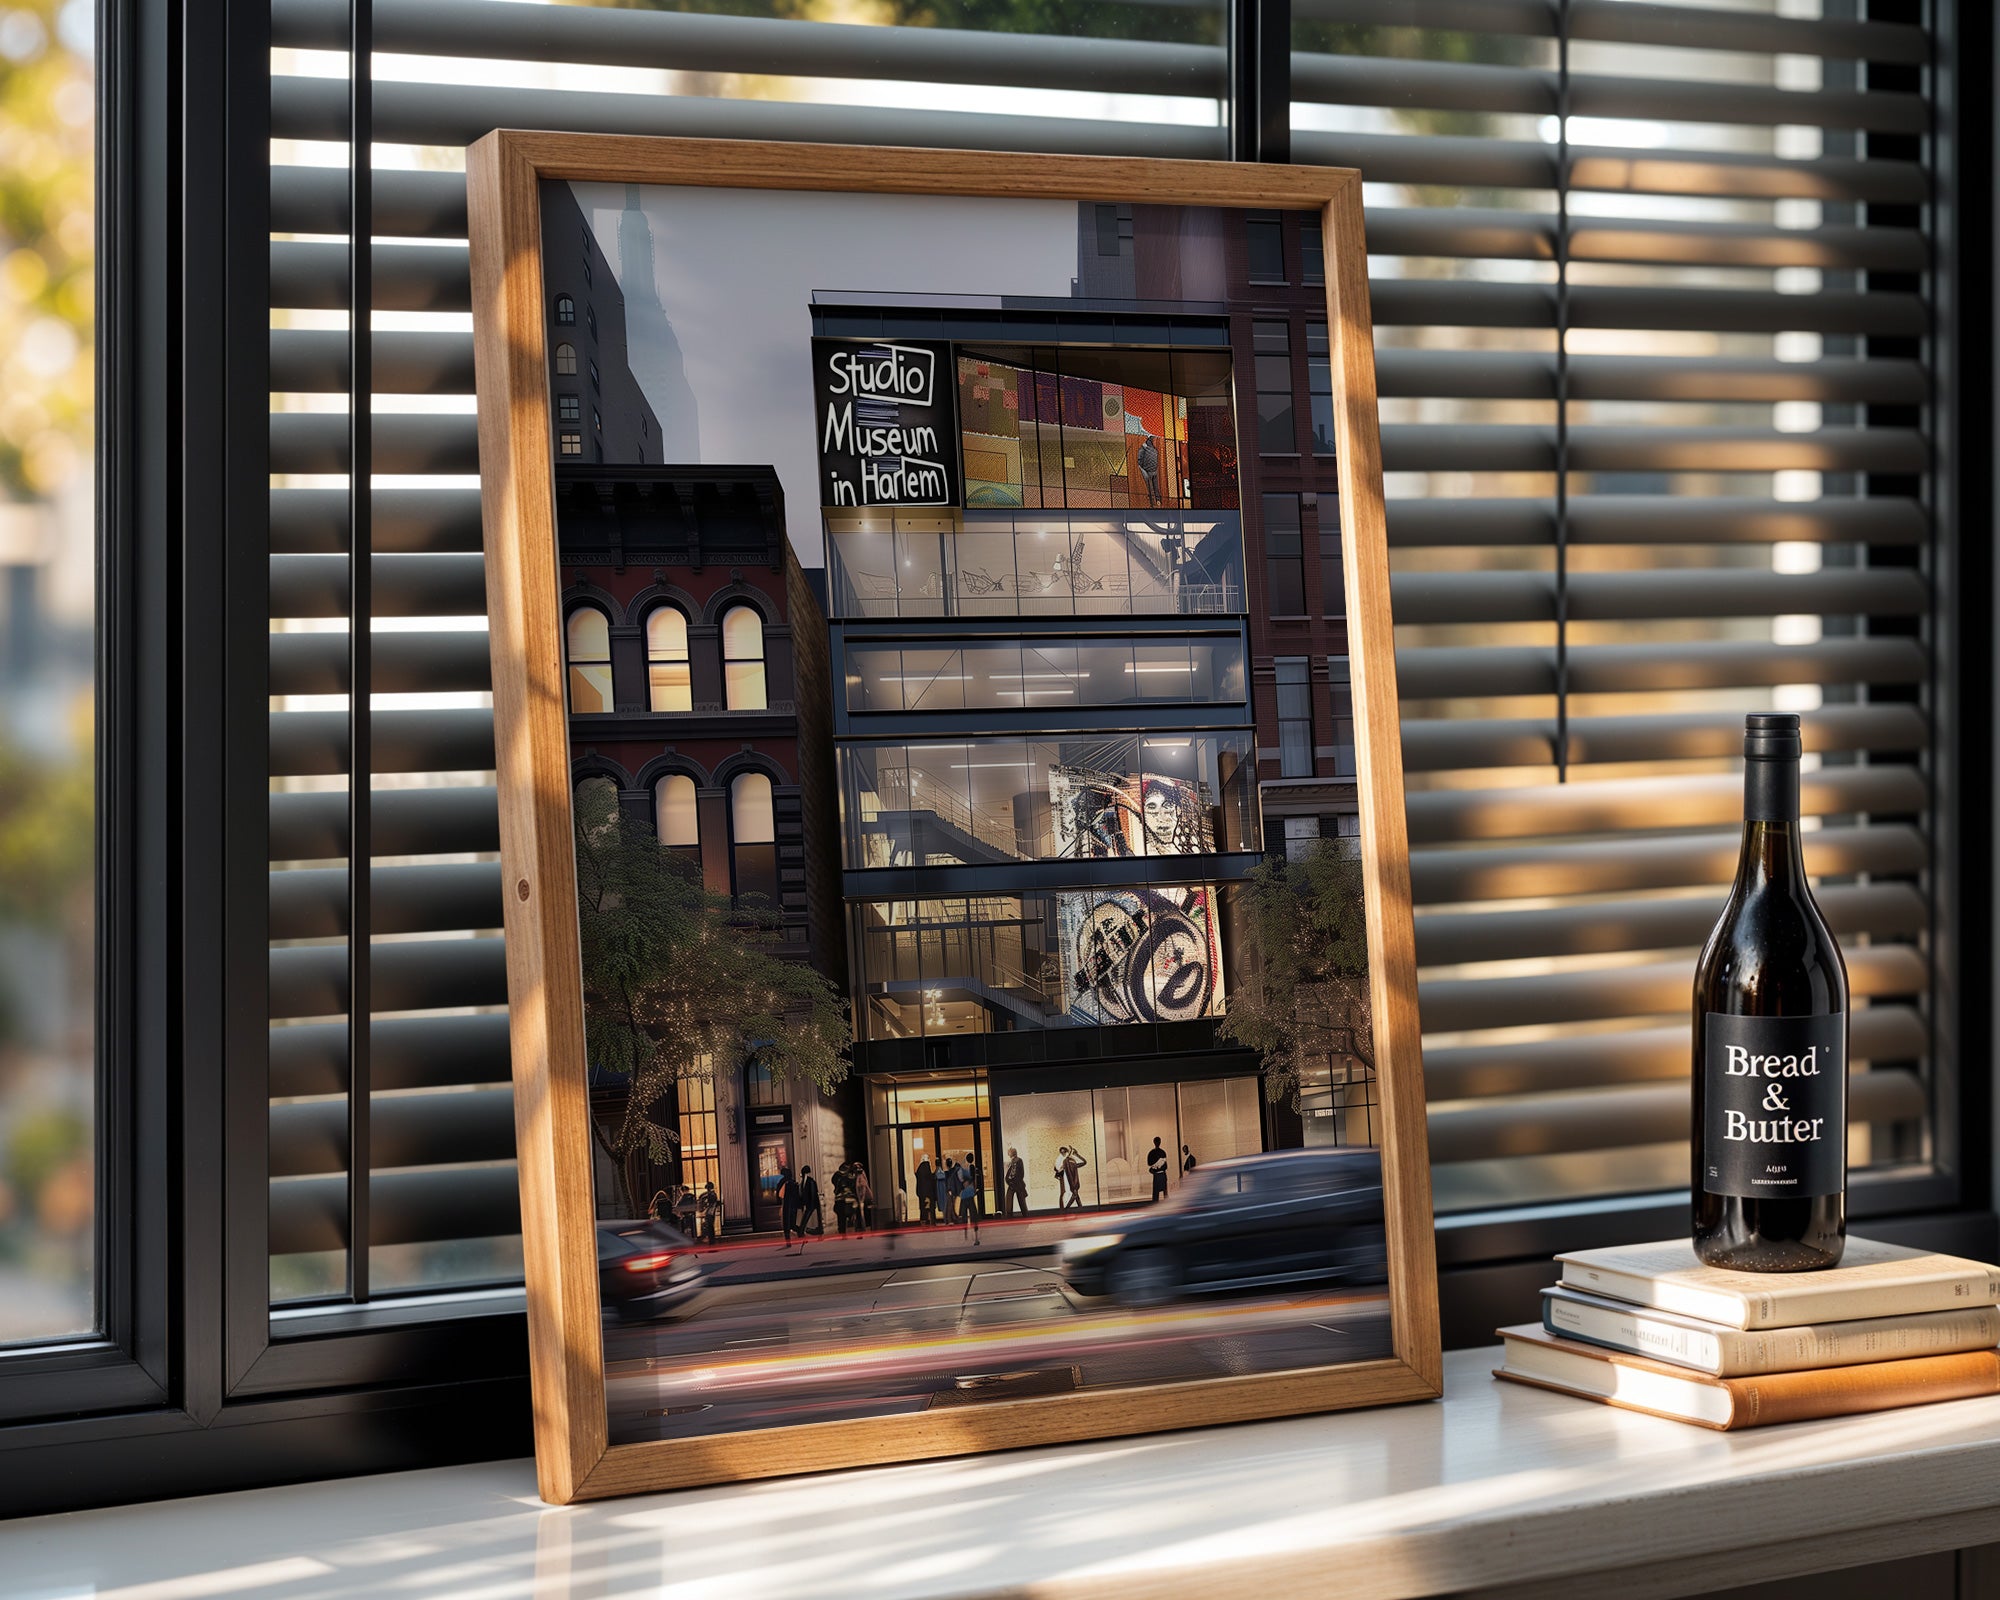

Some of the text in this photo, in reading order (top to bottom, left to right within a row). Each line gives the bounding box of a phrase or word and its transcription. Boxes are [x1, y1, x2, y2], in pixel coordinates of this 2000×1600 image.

[829, 347, 925, 397] Studio
[824, 401, 938, 457] Museum
[831, 456, 941, 507] in Harlem
[1725, 1044, 1820, 1078] Bread
[1762, 1082, 1790, 1112] &
